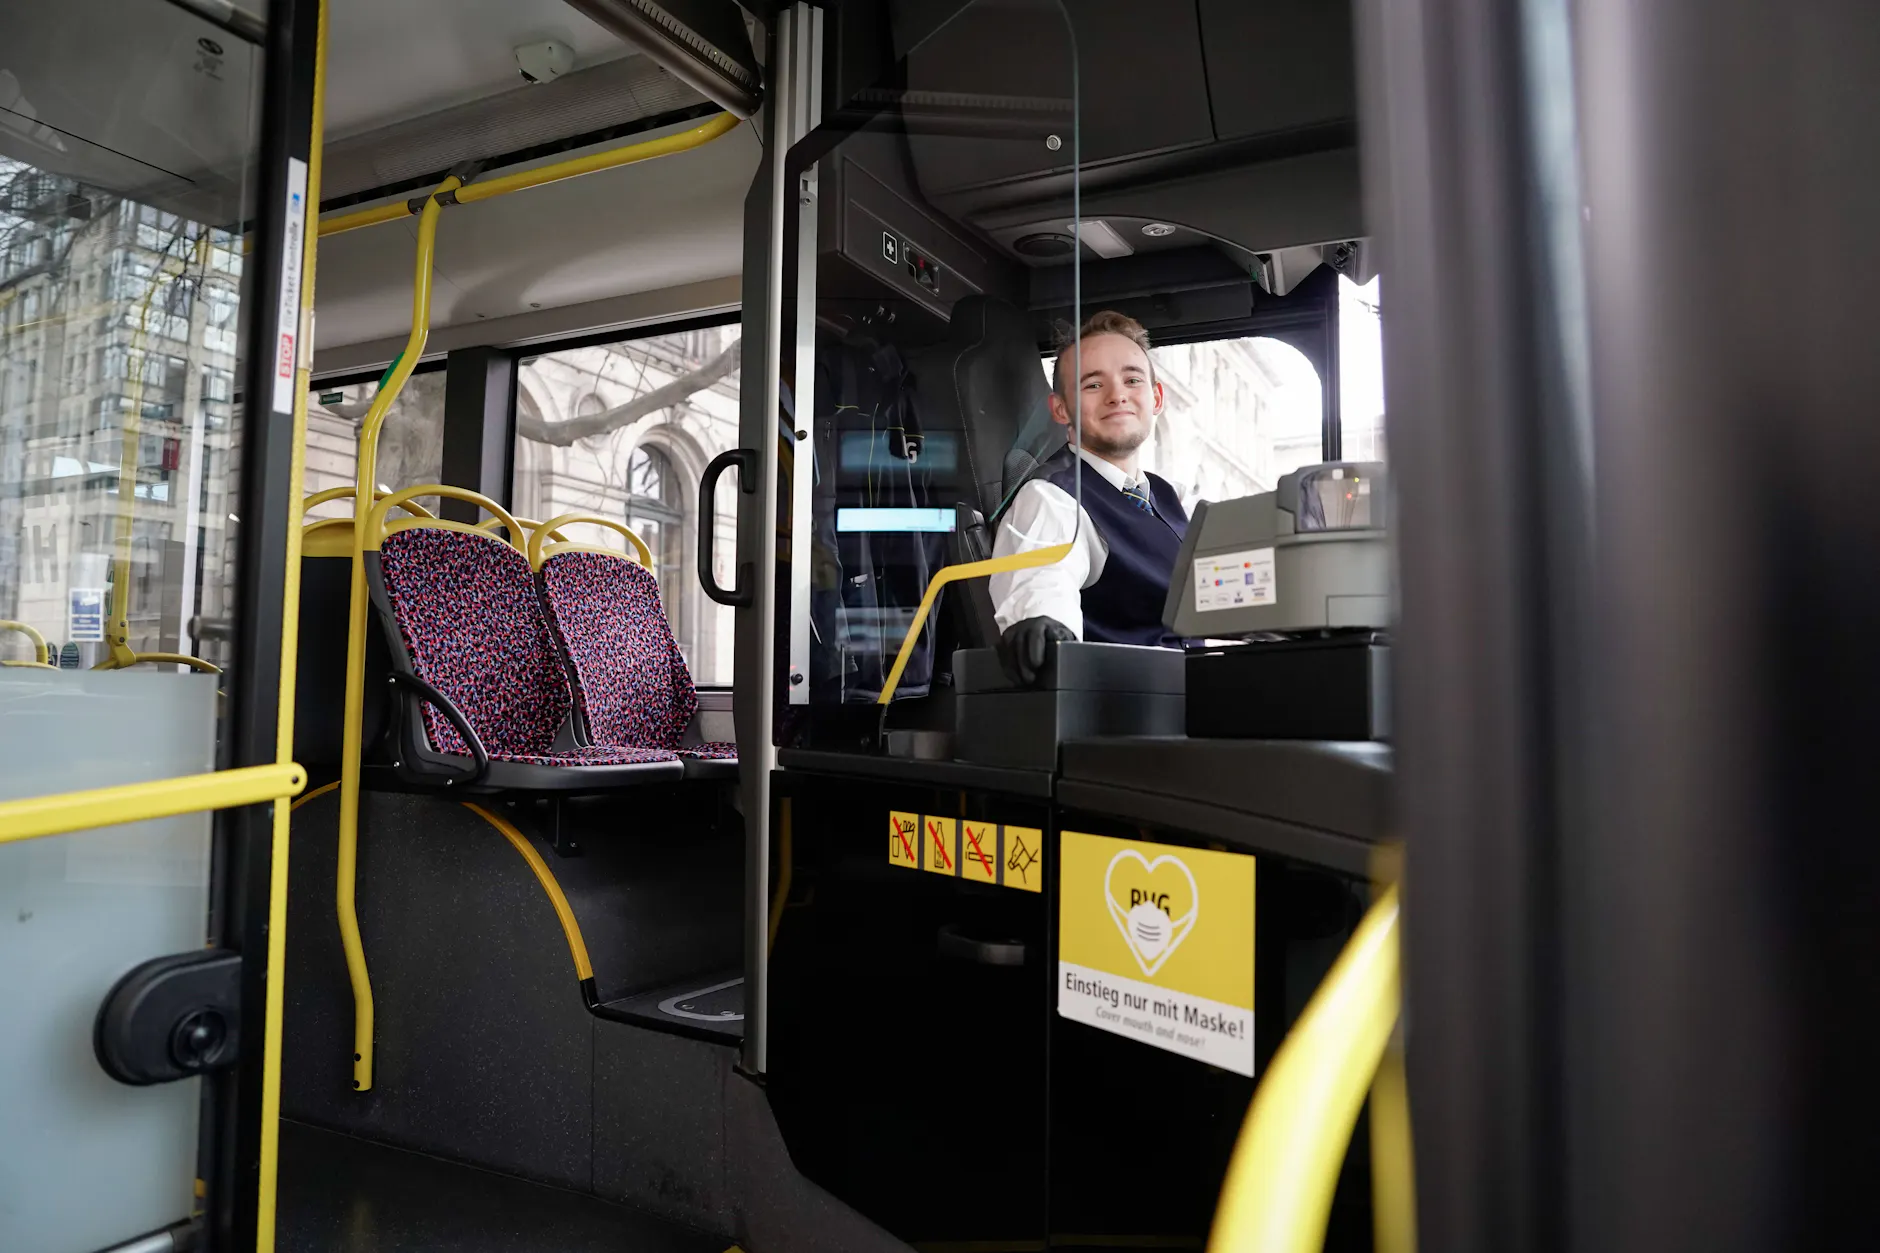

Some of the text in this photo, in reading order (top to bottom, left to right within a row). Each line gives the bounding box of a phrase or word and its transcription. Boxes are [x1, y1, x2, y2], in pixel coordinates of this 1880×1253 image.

[280, 335, 292, 376] STOP
[1066, 972, 1244, 1040] Einstieg nur mit Maske!
[1095, 1006, 1121, 1022] Cover
[1122, 1015, 1154, 1034] mouth
[1155, 1024, 1175, 1040] and
